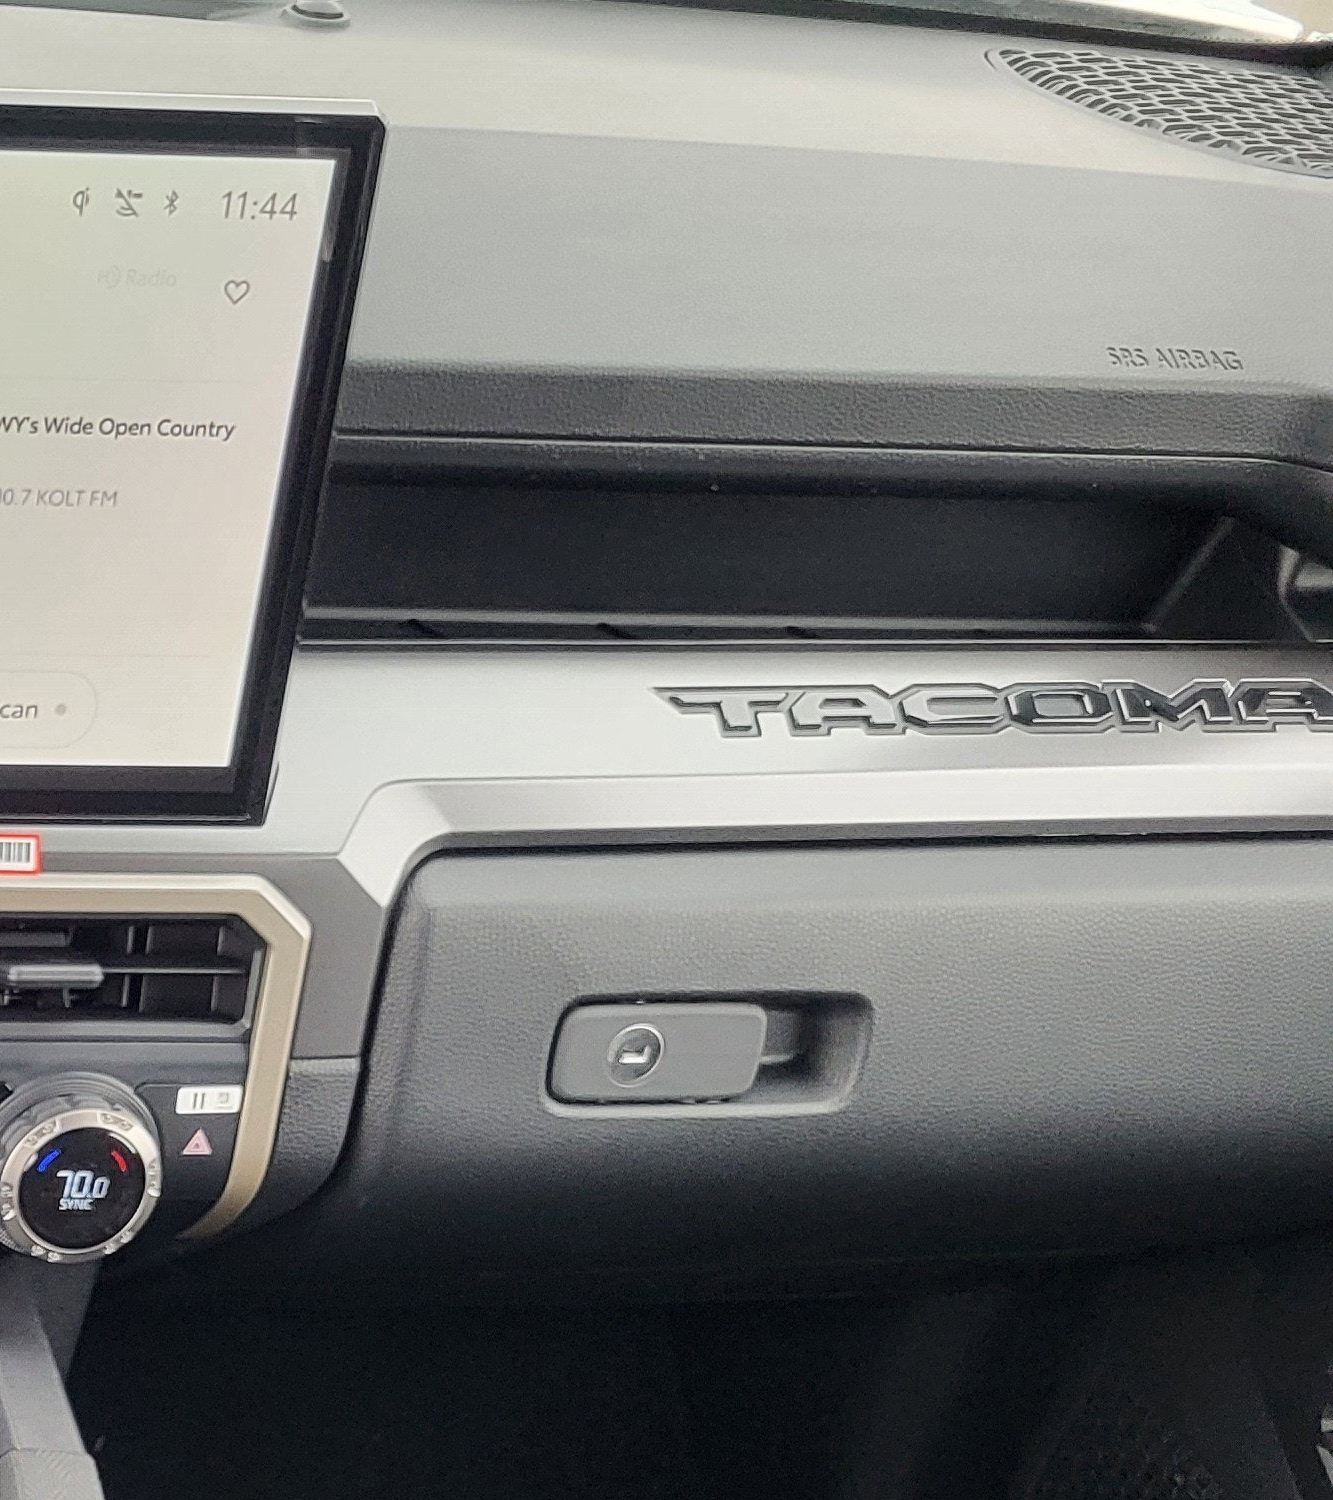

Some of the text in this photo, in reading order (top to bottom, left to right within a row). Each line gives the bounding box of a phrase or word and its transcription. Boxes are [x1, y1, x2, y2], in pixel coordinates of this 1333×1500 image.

[222, 190, 298, 221] 11:44
[1106, 346, 1244, 371] SRS AIRBAG
[43, 416, 95, 438] Wide
[99, 418, 152, 443] Open
[156, 418, 236, 442] Country
[35, 488, 86, 508] KOLT
[88, 489, 119, 509] FM
[649, 679, 1333, 737] TACOMA
[56, 1168, 111, 1200] 70.0
[58, 1199, 97, 1212] SYNC
